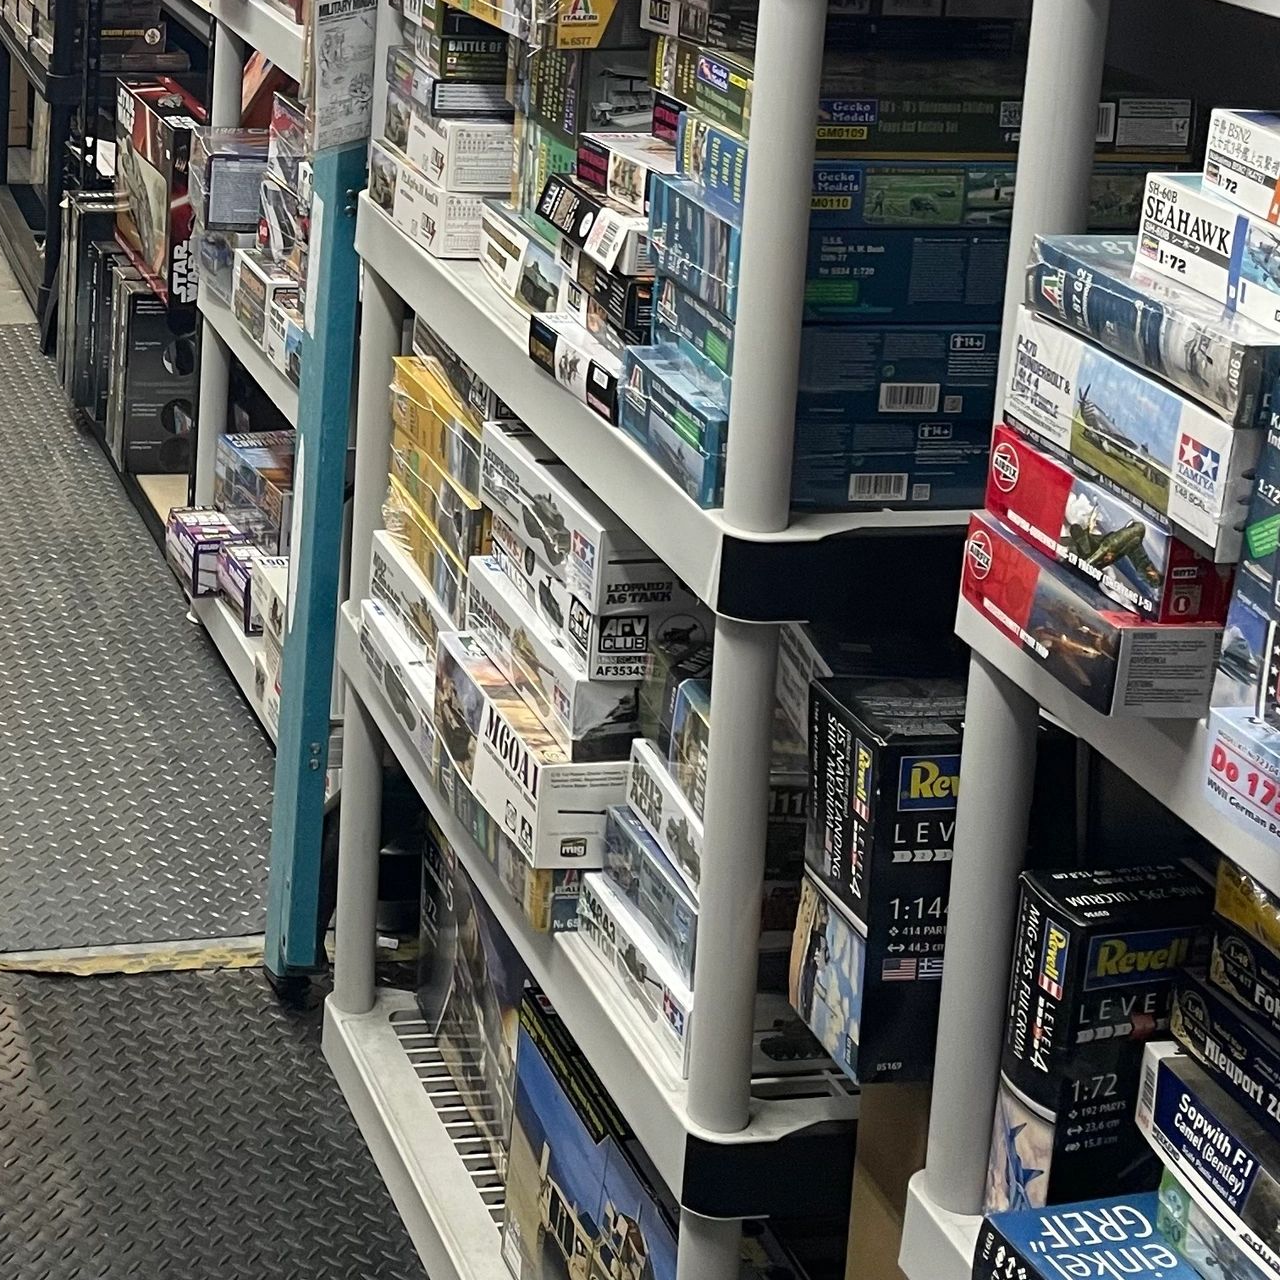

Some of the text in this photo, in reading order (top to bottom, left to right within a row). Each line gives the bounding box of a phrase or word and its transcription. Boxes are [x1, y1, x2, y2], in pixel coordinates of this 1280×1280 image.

[650, 0, 671, 21] MB
[448, 40, 502, 52] BATTLE OF
[832, 113, 875, 122] Models
[833, 102, 871, 112] Gecko
[817, 128, 865, 138] GM0109
[818, 172, 855, 182] Gecko
[818, 182, 859, 192] Models
[1217, 173, 1238, 194] 1:72
[810, 198, 849, 208] M0110
[1148, 180, 1178, 204] SH-60B
[1145, 195, 1230, 255] SEAHAWK
[172, 240, 189, 297] STAR
[1159, 250, 1186, 274] 1:72
[994, 455, 1017, 482] AIRFIX
[1178, 463, 1215, 494] TAMIYA
[970, 541, 991, 569] AIRFIX
[607, 582, 664, 593] LEOPARD
[628, 592, 672, 603] TANK
[602, 618, 647, 636] AFV
[602, 637, 646, 650] CLUB
[485, 705, 540, 798] M60A1
[1210, 744, 1238, 783] Do
[825, 713, 837, 828] SHIP MEDIUM
[834, 748, 846, 797] NAVY
[856, 747, 871, 802] Revell
[909, 761, 960, 799] Rev
[1208, 777, 1229, 800] WWII
[1228, 797, 1267, 831] German
[831, 799, 845, 880] LANDING
[894, 821, 955, 844] LEV
[561, 844, 585, 856] mig
[890, 896, 951, 920] 1:14
[1066, 893, 1138, 907] FULCRUM
[1045, 927, 1067, 982] Revell
[1096, 937, 1190, 978] Revell
[1013, 904, 1041, 1060] MiG-29S FULCRUM
[1079, 992, 1172, 1025] LEVE
[1029, 1000, 1056, 1073] LEVEL 4
[1071, 1073, 1118, 1102] 1:72
[1081, 1100, 1127, 1117] 192 PARTS
[1178, 1093, 1255, 1178] Sopwith F.1
[1174, 1111, 1247, 1197] Camel (Bentley)
